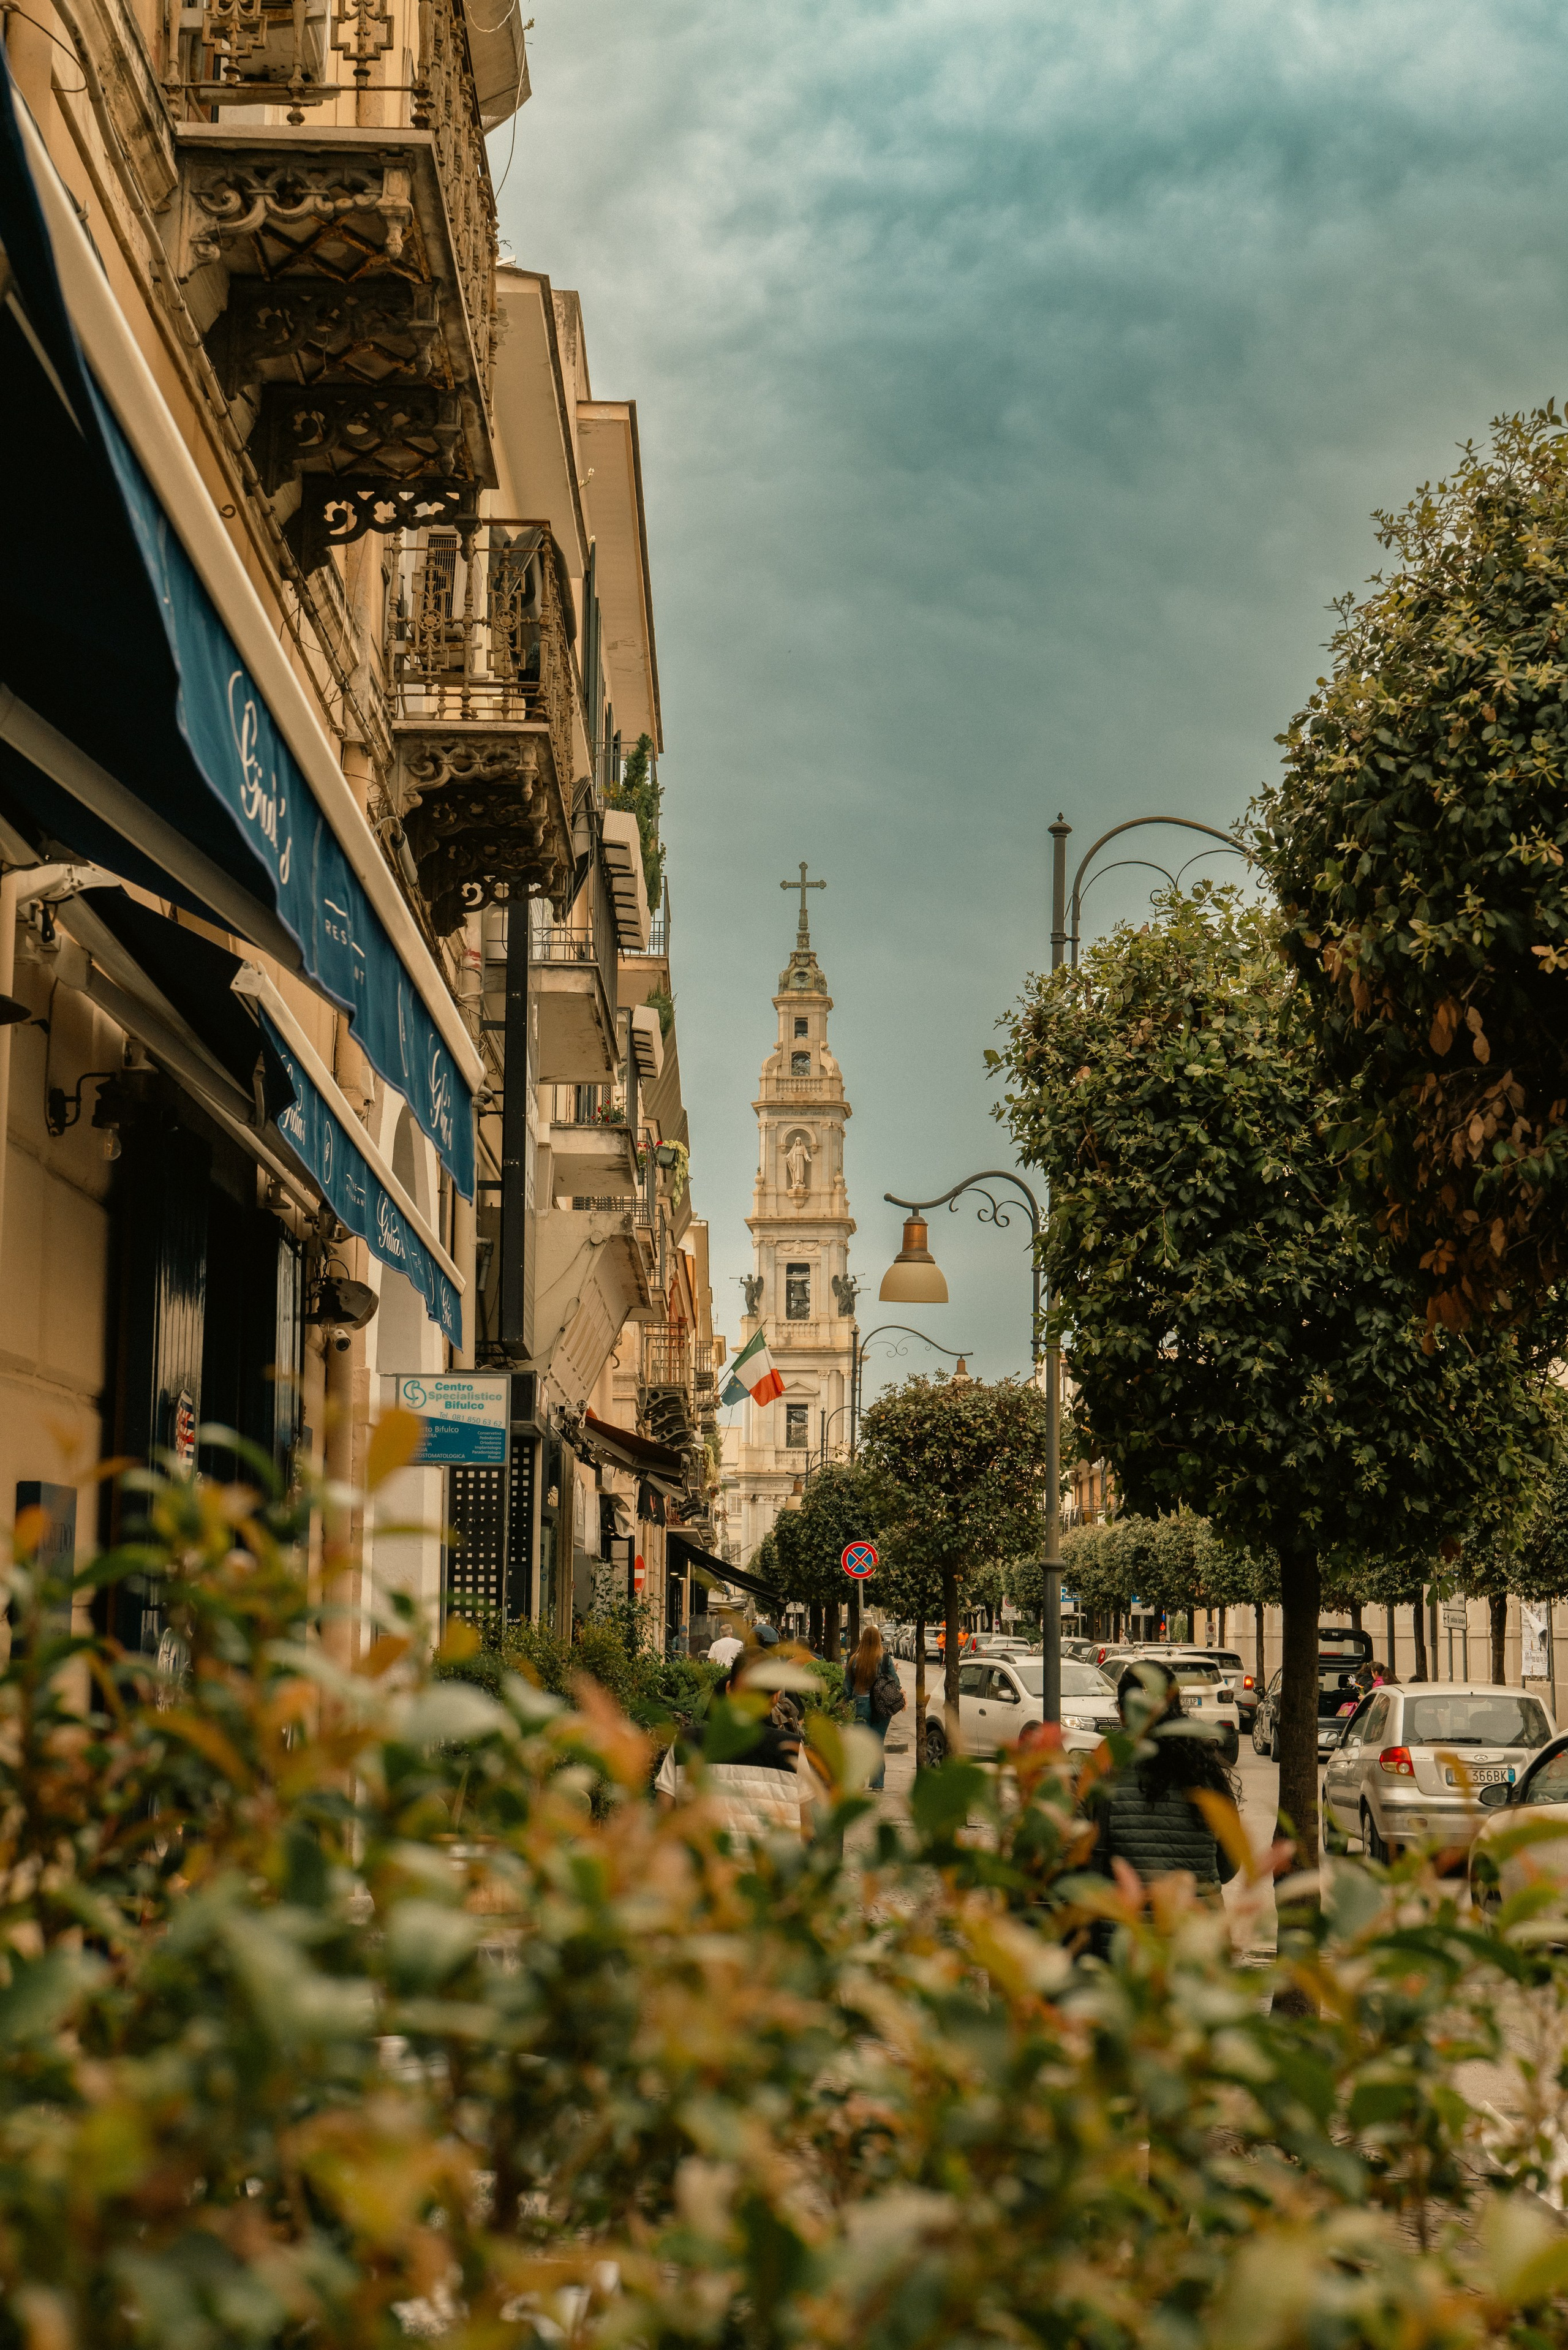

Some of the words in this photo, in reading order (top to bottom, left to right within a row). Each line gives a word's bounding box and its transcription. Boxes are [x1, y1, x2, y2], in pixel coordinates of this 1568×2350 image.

[435, 1382, 473, 1391] Centro
[428, 1392, 502, 1401] Specialistico
[445, 1401, 484, 1410] Bifulco
[1472, 1770, 1508, 1782] 366BK
